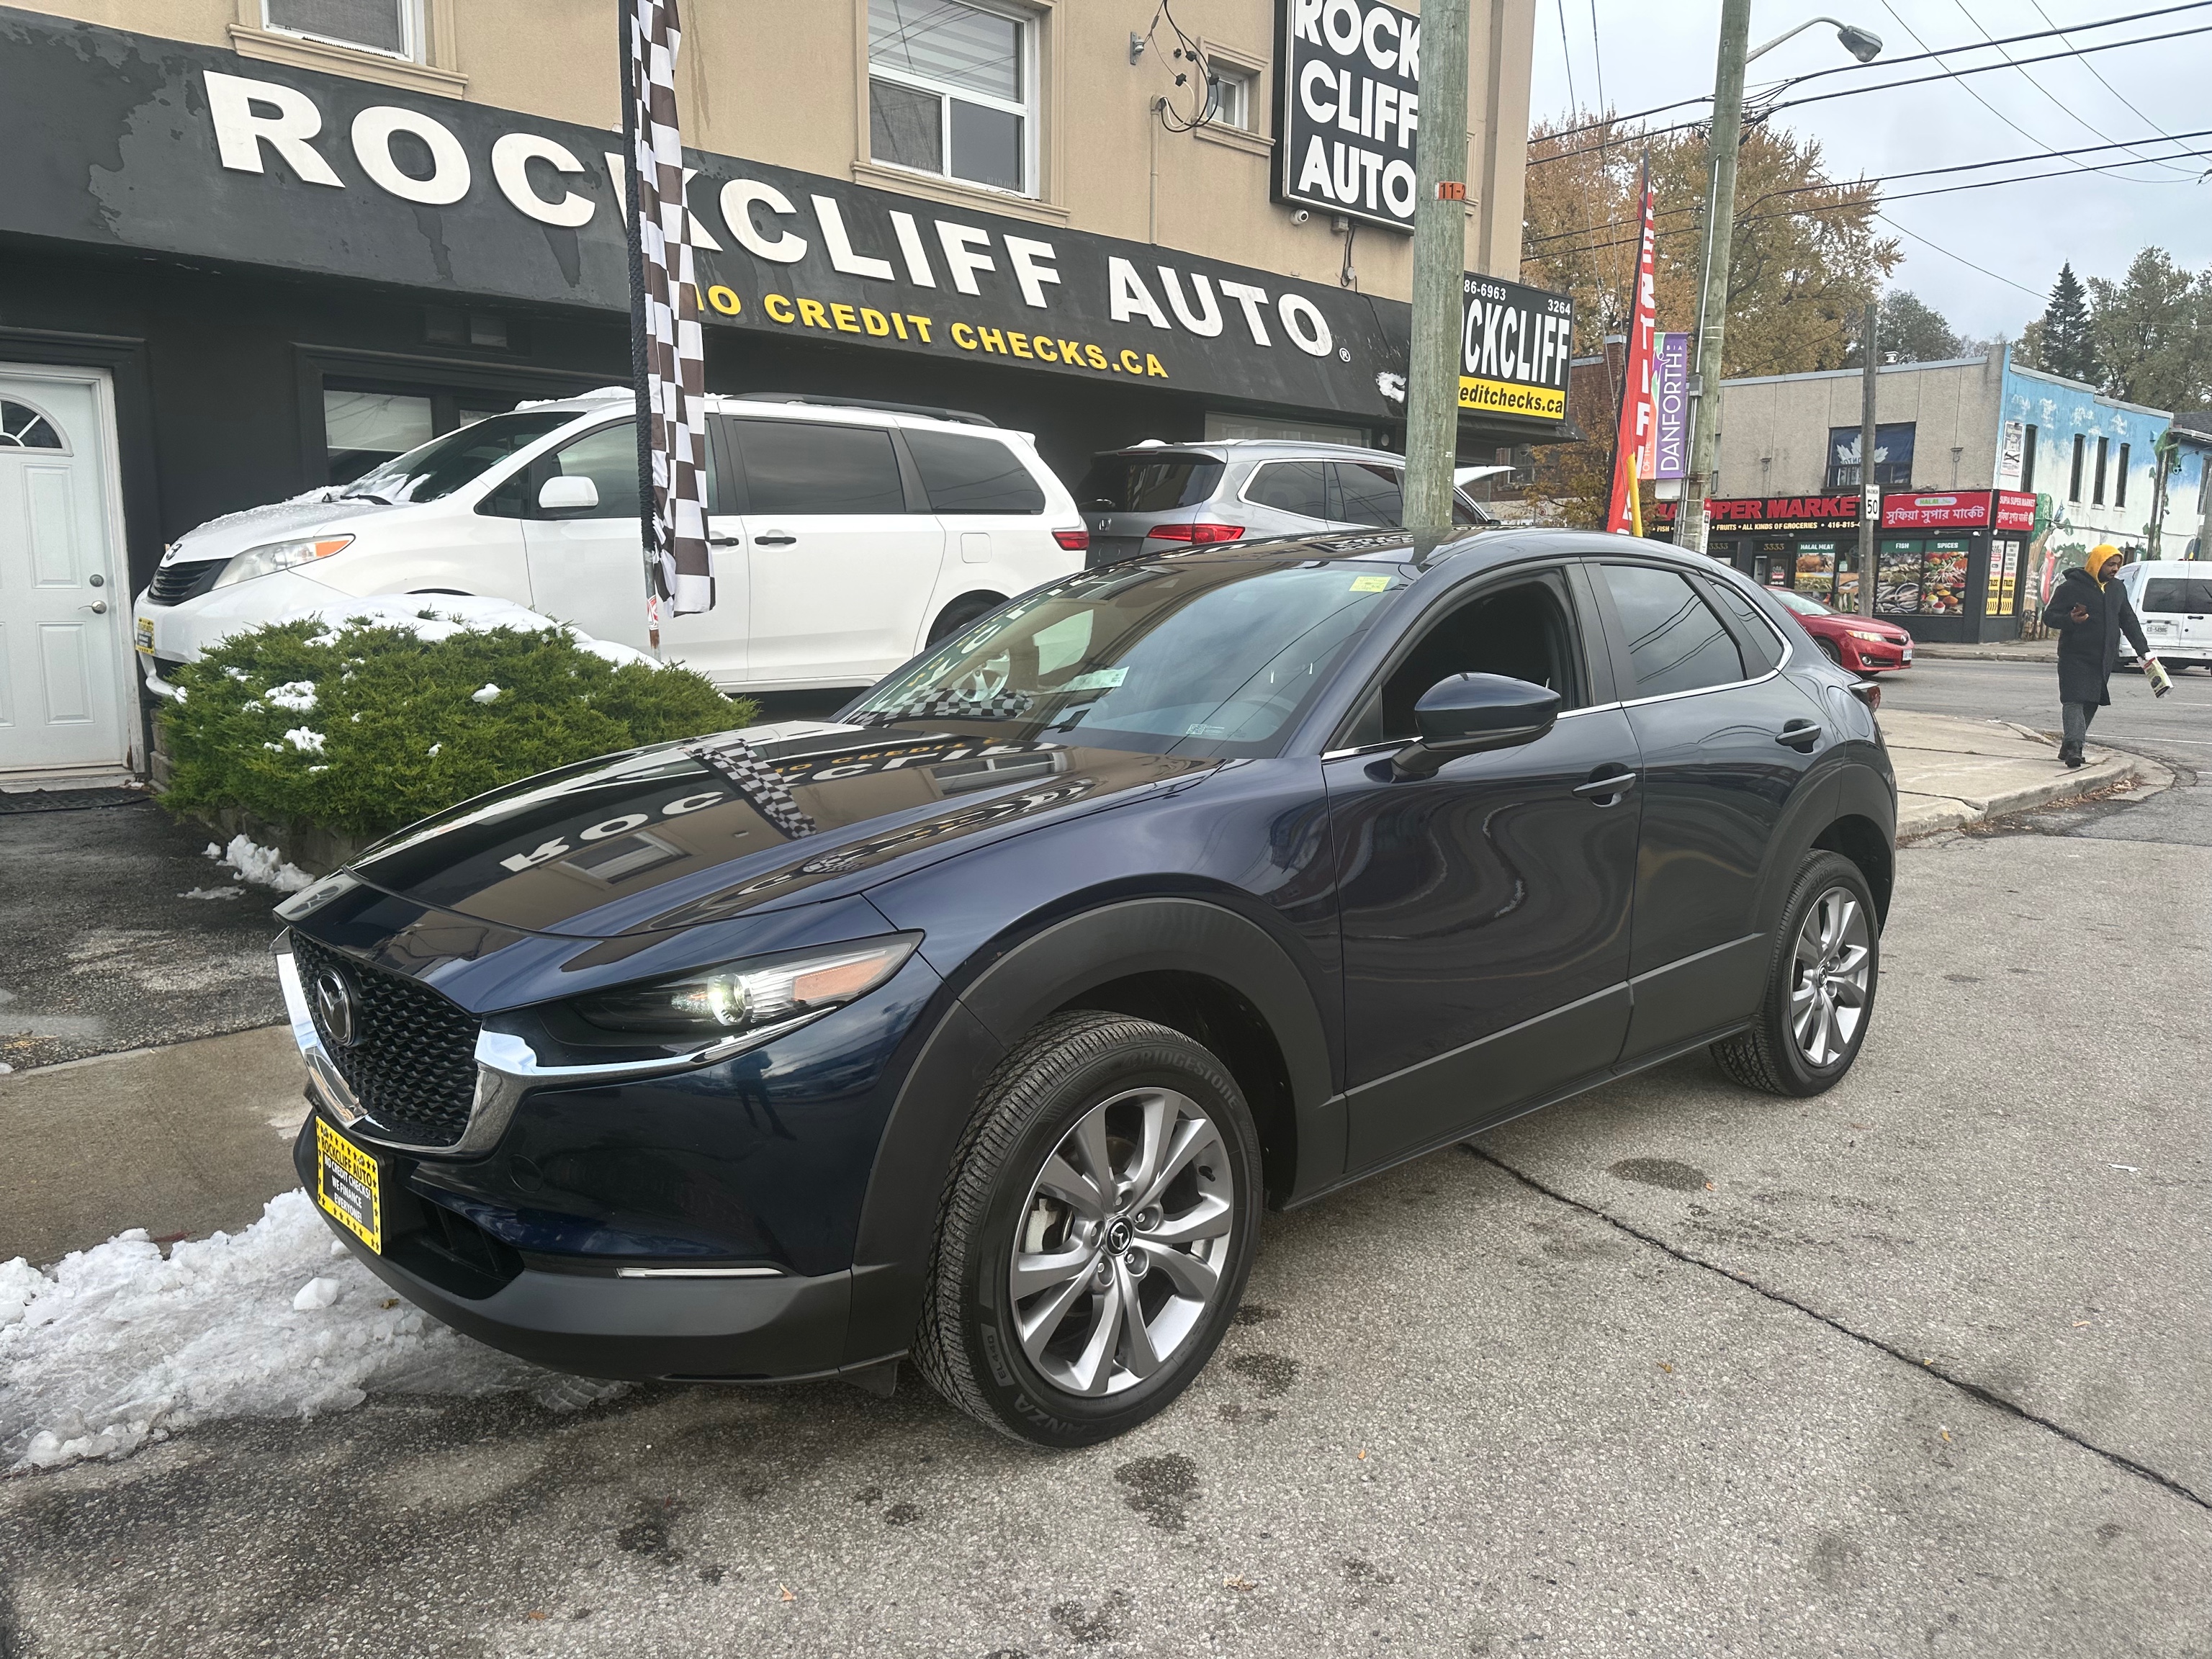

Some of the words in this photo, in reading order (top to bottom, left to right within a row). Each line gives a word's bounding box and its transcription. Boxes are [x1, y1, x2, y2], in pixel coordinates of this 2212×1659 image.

[1300, 59, 1419, 149] CLIFF
[1298, 134, 1416, 218] AUTO
[1464, 279, 1506, 301] 86-6963
[1548, 299, 1571, 315] 3264
[765, 293, 932, 344] CREDIT
[951, 321, 1168, 379] CHECKS.CA
[1462, 298, 1570, 386] CKCLIFF
[1660, 353, 1683, 471] DANFORTH
[1767, 496, 1861, 518] MARKE
[1868, 500, 1878, 514] 50
[320, 1136, 352, 1172] ROCKCLIFF
[353, 1163, 372, 1187] AUTO
[325, 1154, 331, 1168] NO
[331, 1160, 348, 1182] CREDIT
[349, 1176, 371, 1200] CHECKS!
[332, 1175, 340, 1192] WE
[341, 1183, 362, 1209] FINANCE
[334, 1192, 362, 1223] EVERYONE!
